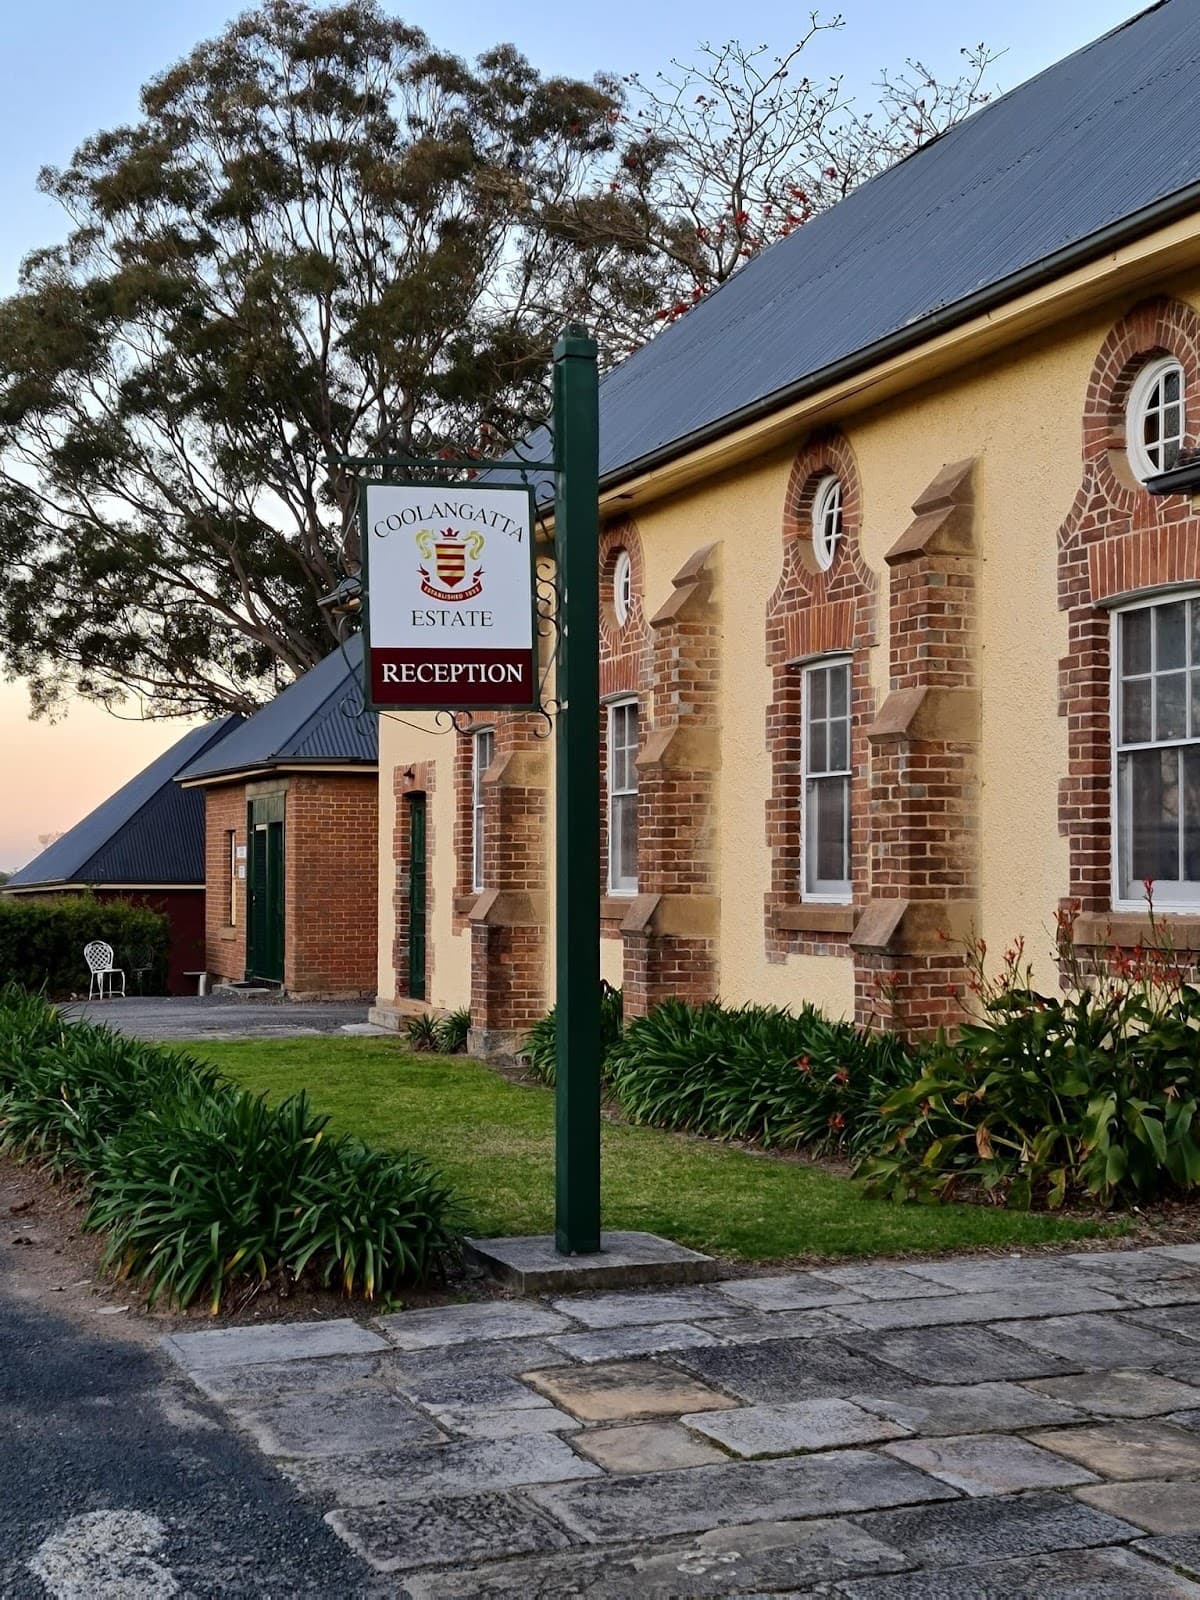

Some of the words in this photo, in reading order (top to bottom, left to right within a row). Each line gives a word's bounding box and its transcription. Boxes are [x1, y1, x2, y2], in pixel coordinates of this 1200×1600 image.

[373, 502, 524, 543] COOLANGATTA
[411, 610, 494, 627] ESTATE
[382, 663, 523, 683] RECEPTION
